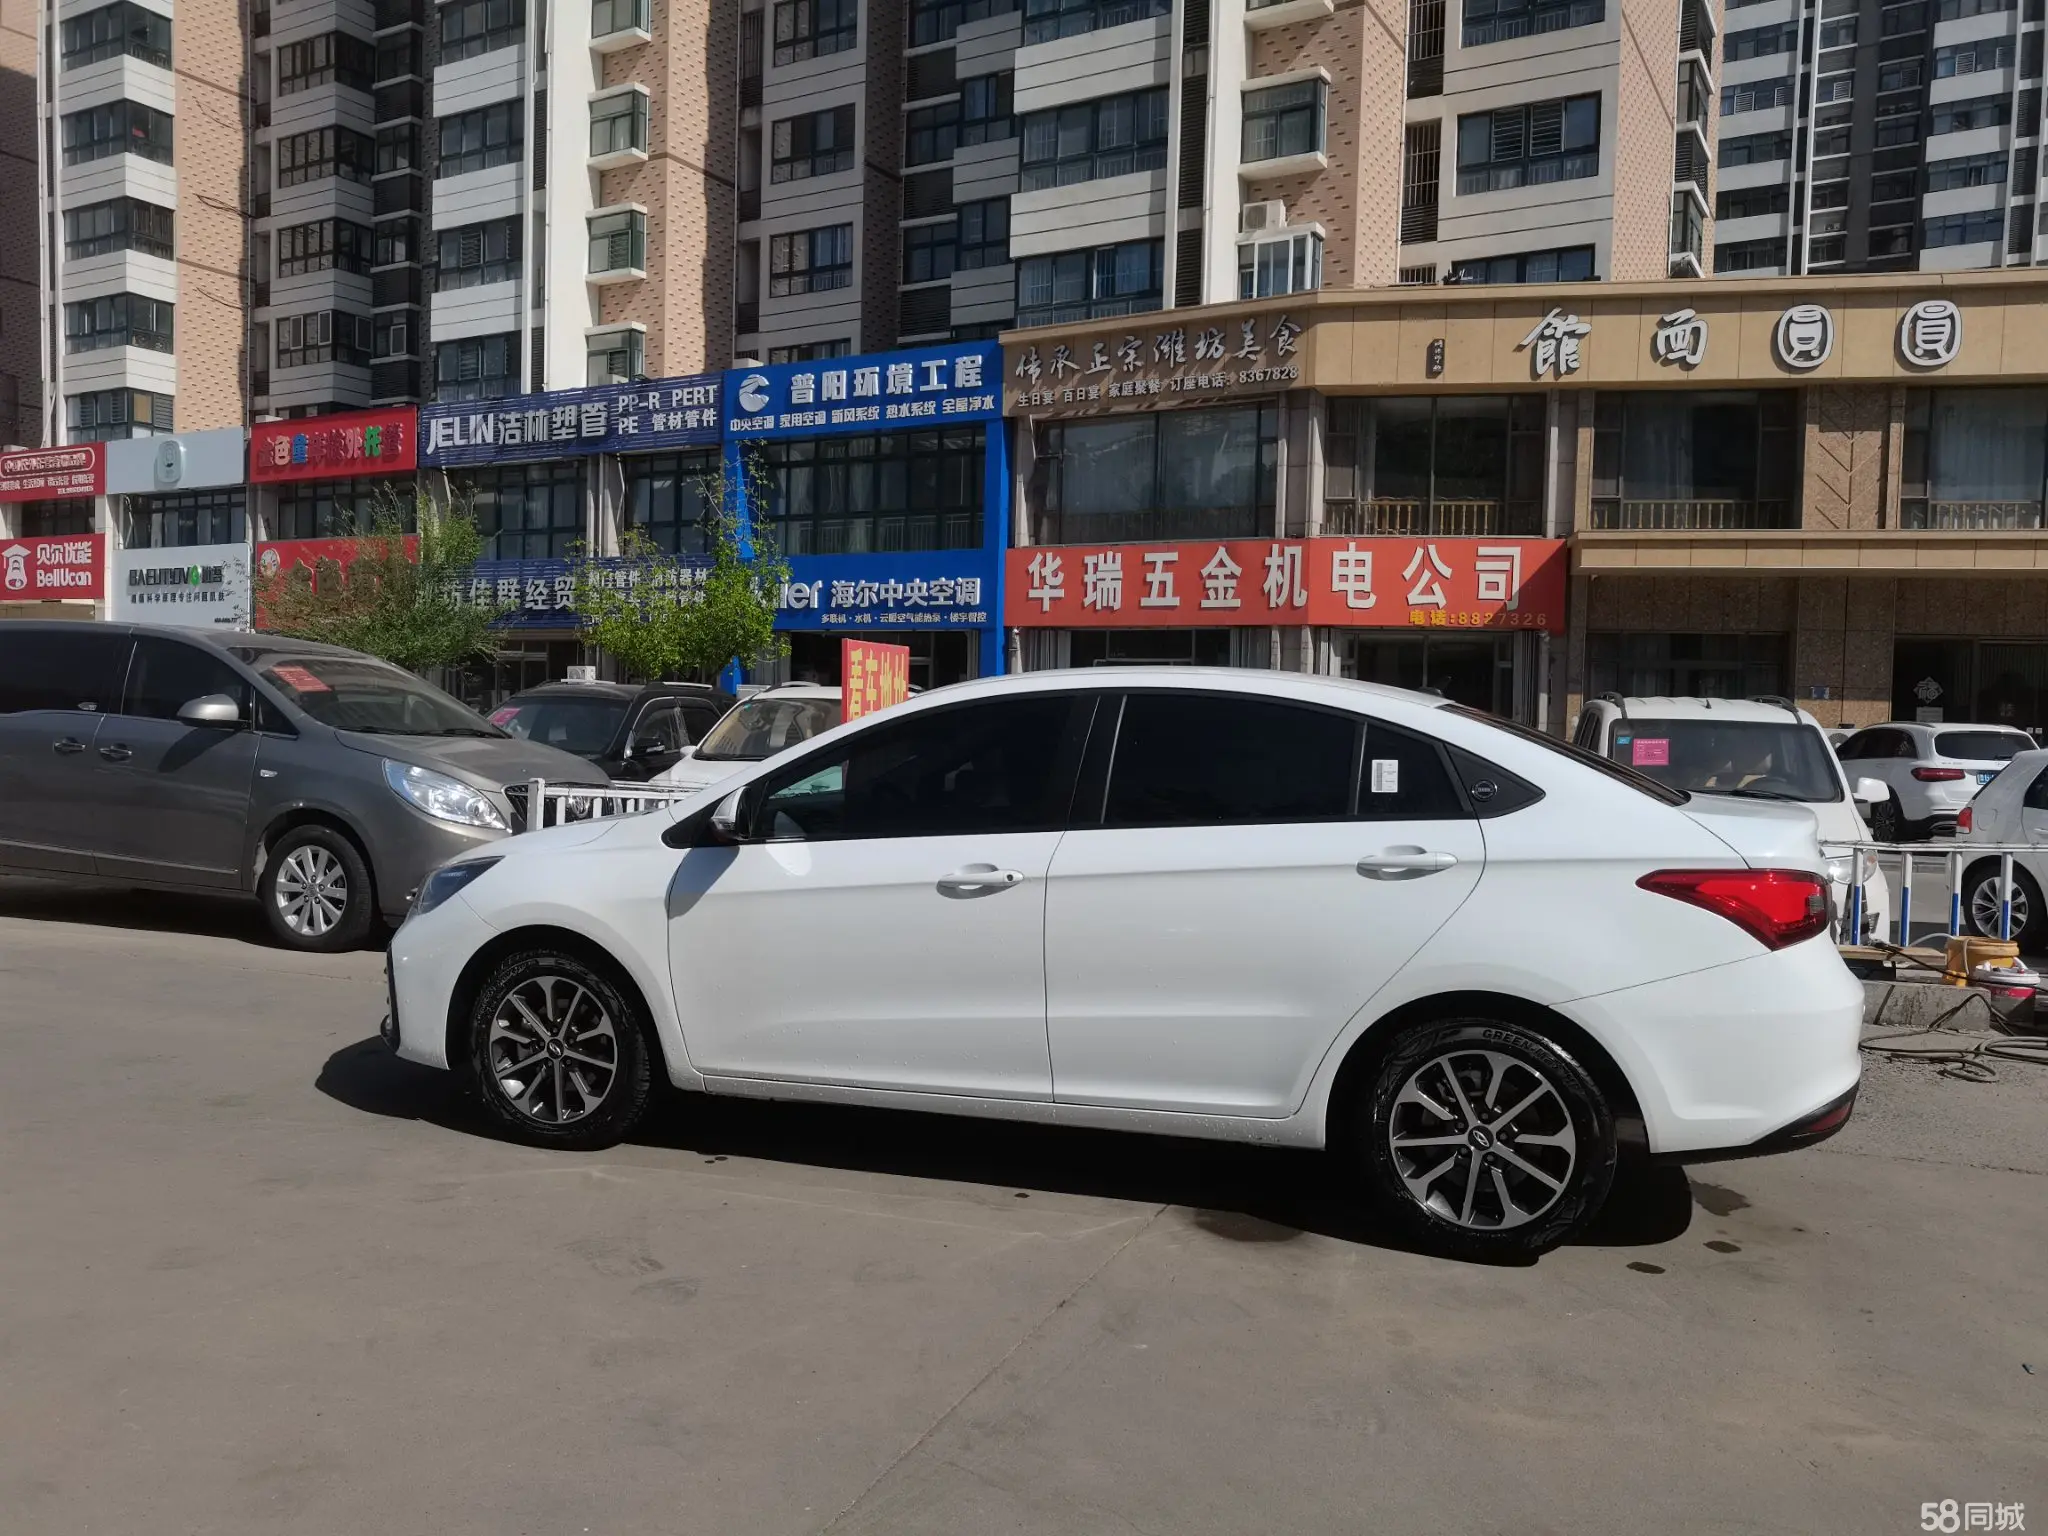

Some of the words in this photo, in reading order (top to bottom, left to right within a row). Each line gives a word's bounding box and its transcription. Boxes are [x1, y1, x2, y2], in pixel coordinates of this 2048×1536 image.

[1015, 315, 1301, 384] 传承正宗潍坊美食
[791, 355, 982, 404] 普阳环境工程
[1018, 391, 1054, 407] 生日宴
[1063, 386, 1099, 402] 百日宴
[1108, 377, 1161, 397] 家庭聚餐
[618, 392, 660, 412] PP-R
[671, 384, 718, 408] PERT
[730, 415, 775, 432] 中央空调
[780, 411, 826, 428] 家用空调
[831, 406, 880, 424] 新风系统
[885, 401, 936, 419] 热水系统
[942, 395, 995, 414] 全屋净水
[426, 413, 493, 454] JELIN
[499, 402, 608, 445] 洁林塑管
[618, 417, 638, 435] PE
[652, 408, 717, 432] 管材管件
[36, 541, 92, 566] 贝尔优能
[830, 577, 981, 608] 海尔中央空调
[1028, 542, 1522, 612] 华瑞五金机电公司
